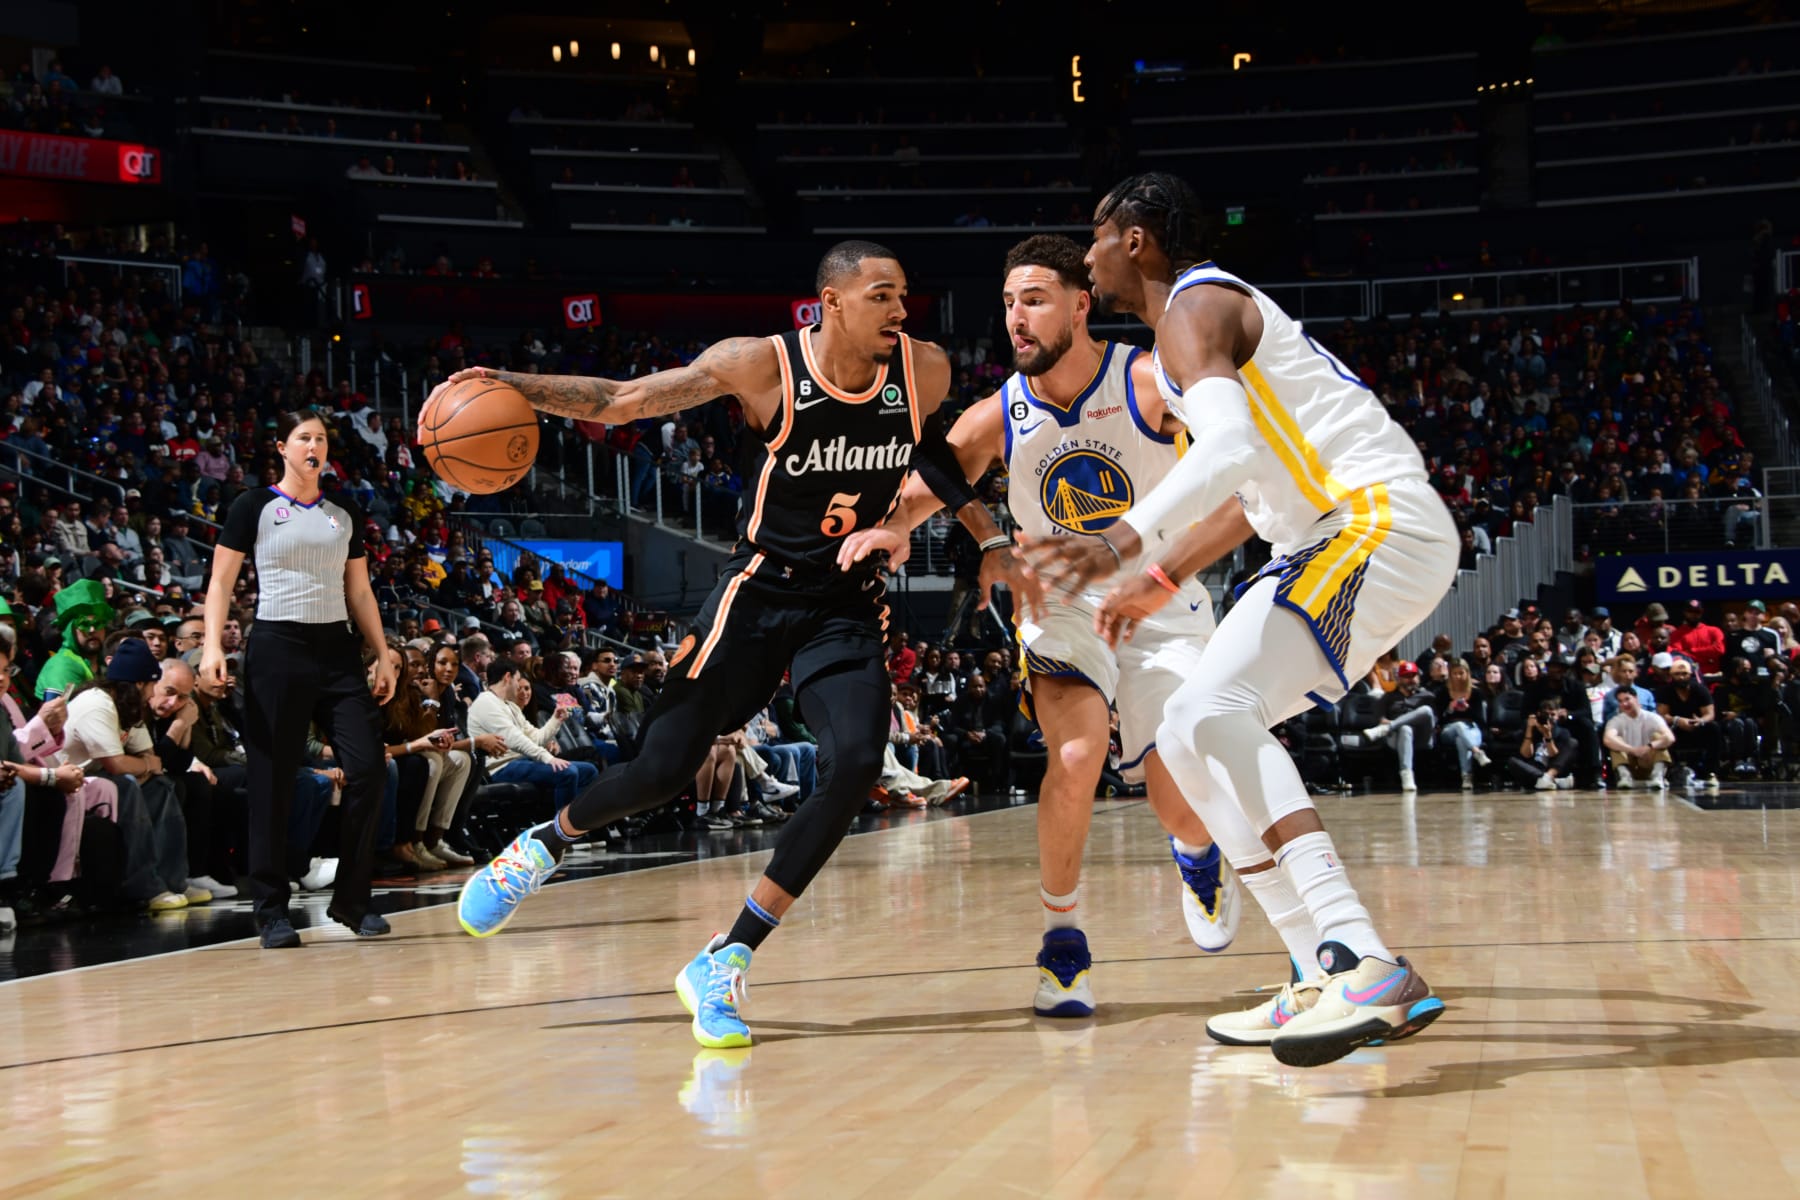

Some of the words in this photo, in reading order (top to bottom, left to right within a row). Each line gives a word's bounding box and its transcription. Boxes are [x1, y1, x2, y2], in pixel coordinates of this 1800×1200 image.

[26, 136, 91, 177] HERE
[123, 150, 155, 177] QT
[567, 299, 594, 322] QT
[800, 380, 812, 396] 6
[1014, 403, 1026, 420] 6
[1087, 404, 1122, 419] Rakuten
[785, 435, 913, 477] Atlanta
[1034, 439, 1079, 477] GOLDEN
[1085, 439, 1123, 461] STATE
[1099, 470, 1115, 494] 11
[820, 492, 862, 537] 5
[1658, 562, 1790, 589] DELTA
